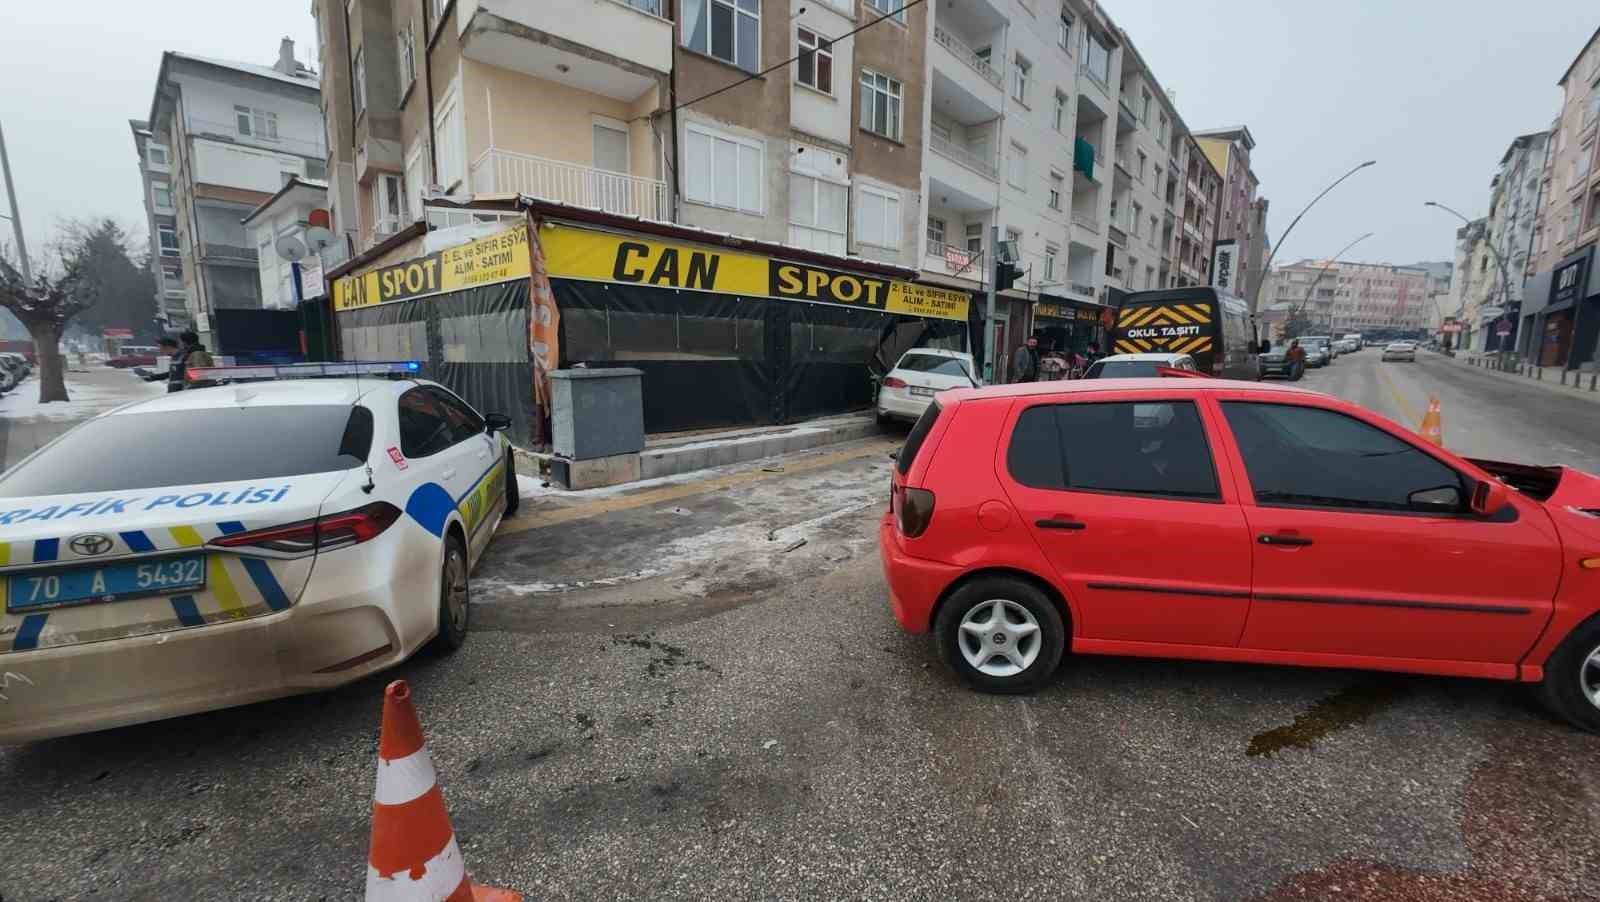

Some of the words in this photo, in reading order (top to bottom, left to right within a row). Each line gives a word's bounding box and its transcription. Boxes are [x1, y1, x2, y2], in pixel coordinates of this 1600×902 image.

[382, 259, 438, 299] SPOT
[613, 241, 720, 291] CAN
[777, 266, 885, 305] SPOT
[343, 274, 367, 308] CAN
[903, 295, 925, 305] ALIM
[1128, 328, 1158, 338] OKUL
[0, 497, 142, 524] RAFİK
[144, 484, 292, 511] POLİSİ
[27, 575, 60, 601] 70
[91, 569, 106, 594] A
[137, 559, 201, 588] 5432
